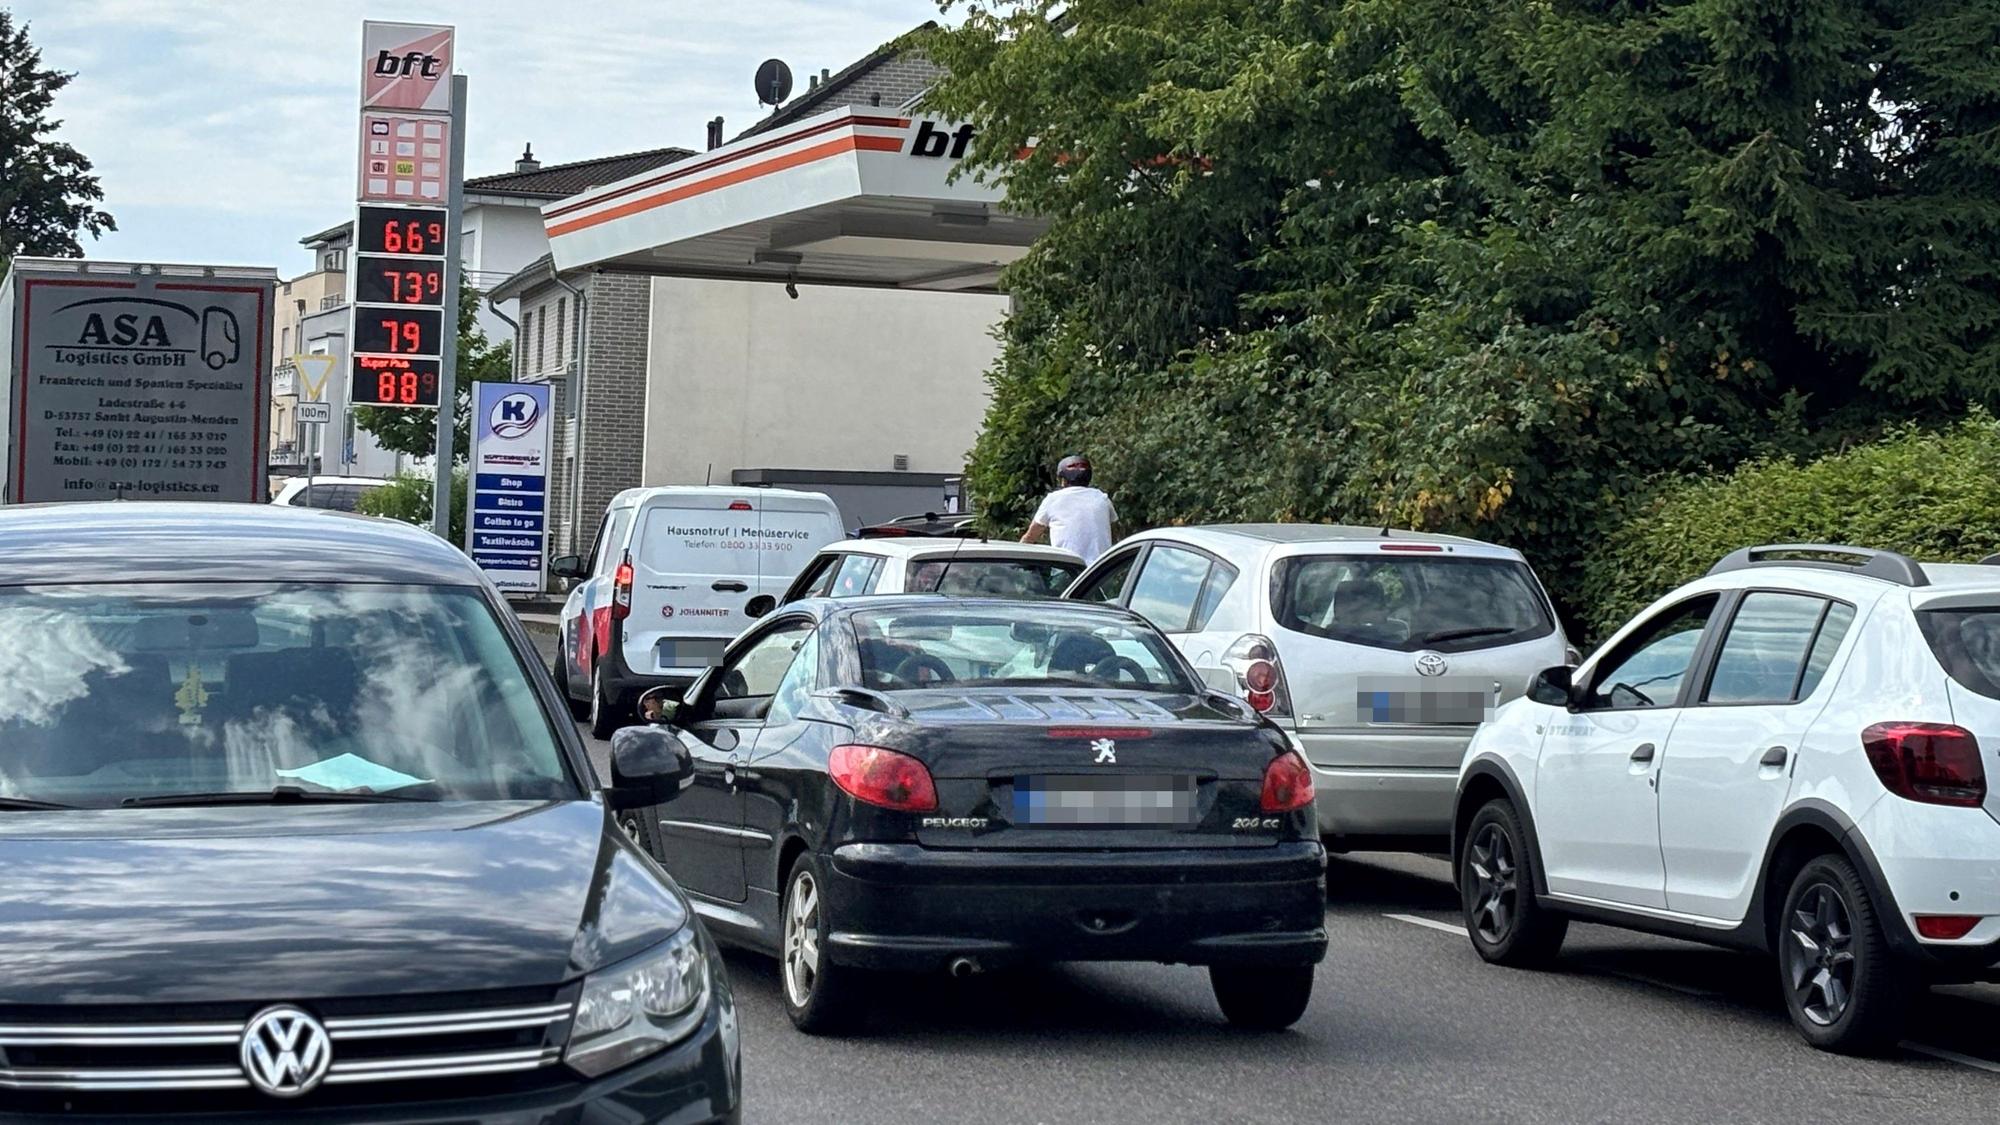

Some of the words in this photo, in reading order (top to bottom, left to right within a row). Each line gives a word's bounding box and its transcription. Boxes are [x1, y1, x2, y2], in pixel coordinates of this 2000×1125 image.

[375, 49, 441, 80] bft
[910, 120, 977, 159] bf
[78, 312, 171, 346] ASA
[55, 350, 129, 367] Logistics
[133, 352, 186, 367] GmbH
[39, 374, 105, 387] Frankreich
[108, 378, 131, 388] und
[135, 377, 184, 391] Spanien
[98, 397, 165, 409] Ladestraße
[502, 400, 525, 421] K
[500, 478, 523, 489] Shop
[667, 526, 730, 537] Hausnotruf
[741, 527, 810, 540] Menüservice
[678, 607, 730, 617] JOHANNITER
[922, 817, 989, 828] PEUGEOT
[1232, 817, 1260, 829] 206
